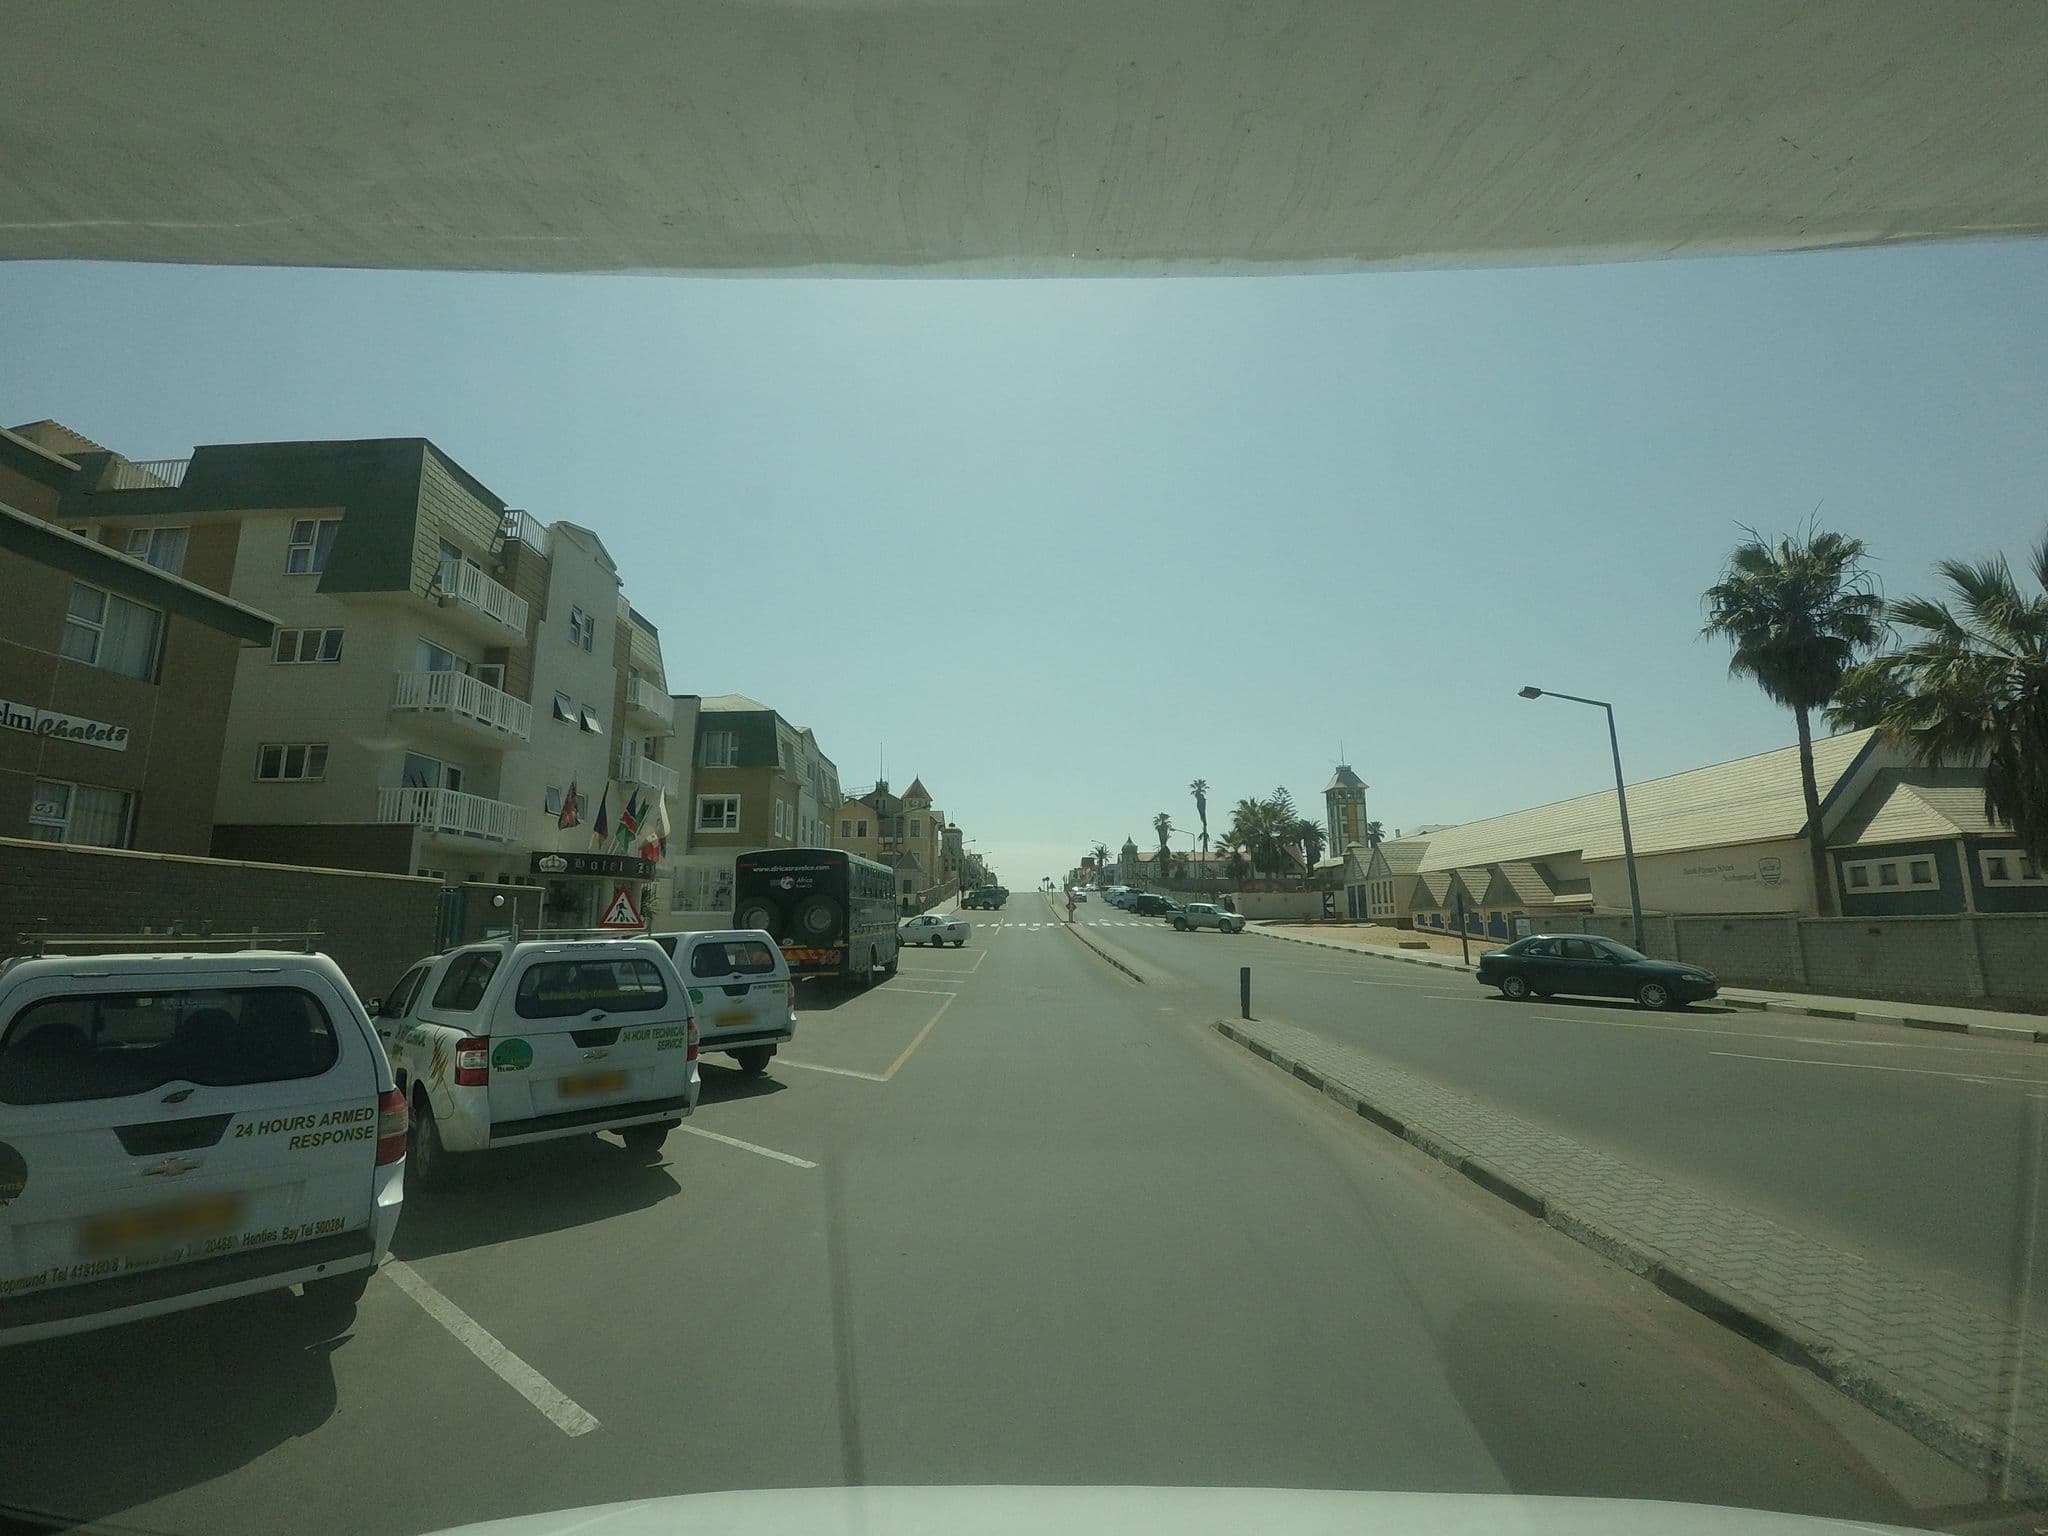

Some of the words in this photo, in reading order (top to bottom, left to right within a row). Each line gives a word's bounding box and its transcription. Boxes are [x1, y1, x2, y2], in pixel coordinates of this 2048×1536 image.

[0, 702, 32, 730] lm
[38, 718, 128, 742] Chalets
[235, 1123, 253, 1138] 24
[257, 1114, 316, 1136] HOURS
[318, 1107, 375, 1128] ARMED
[289, 1125, 375, 1150] RESPONSE
[282, 1225, 299, 1242] Bay
[300, 1223, 315, 1238] Tel
